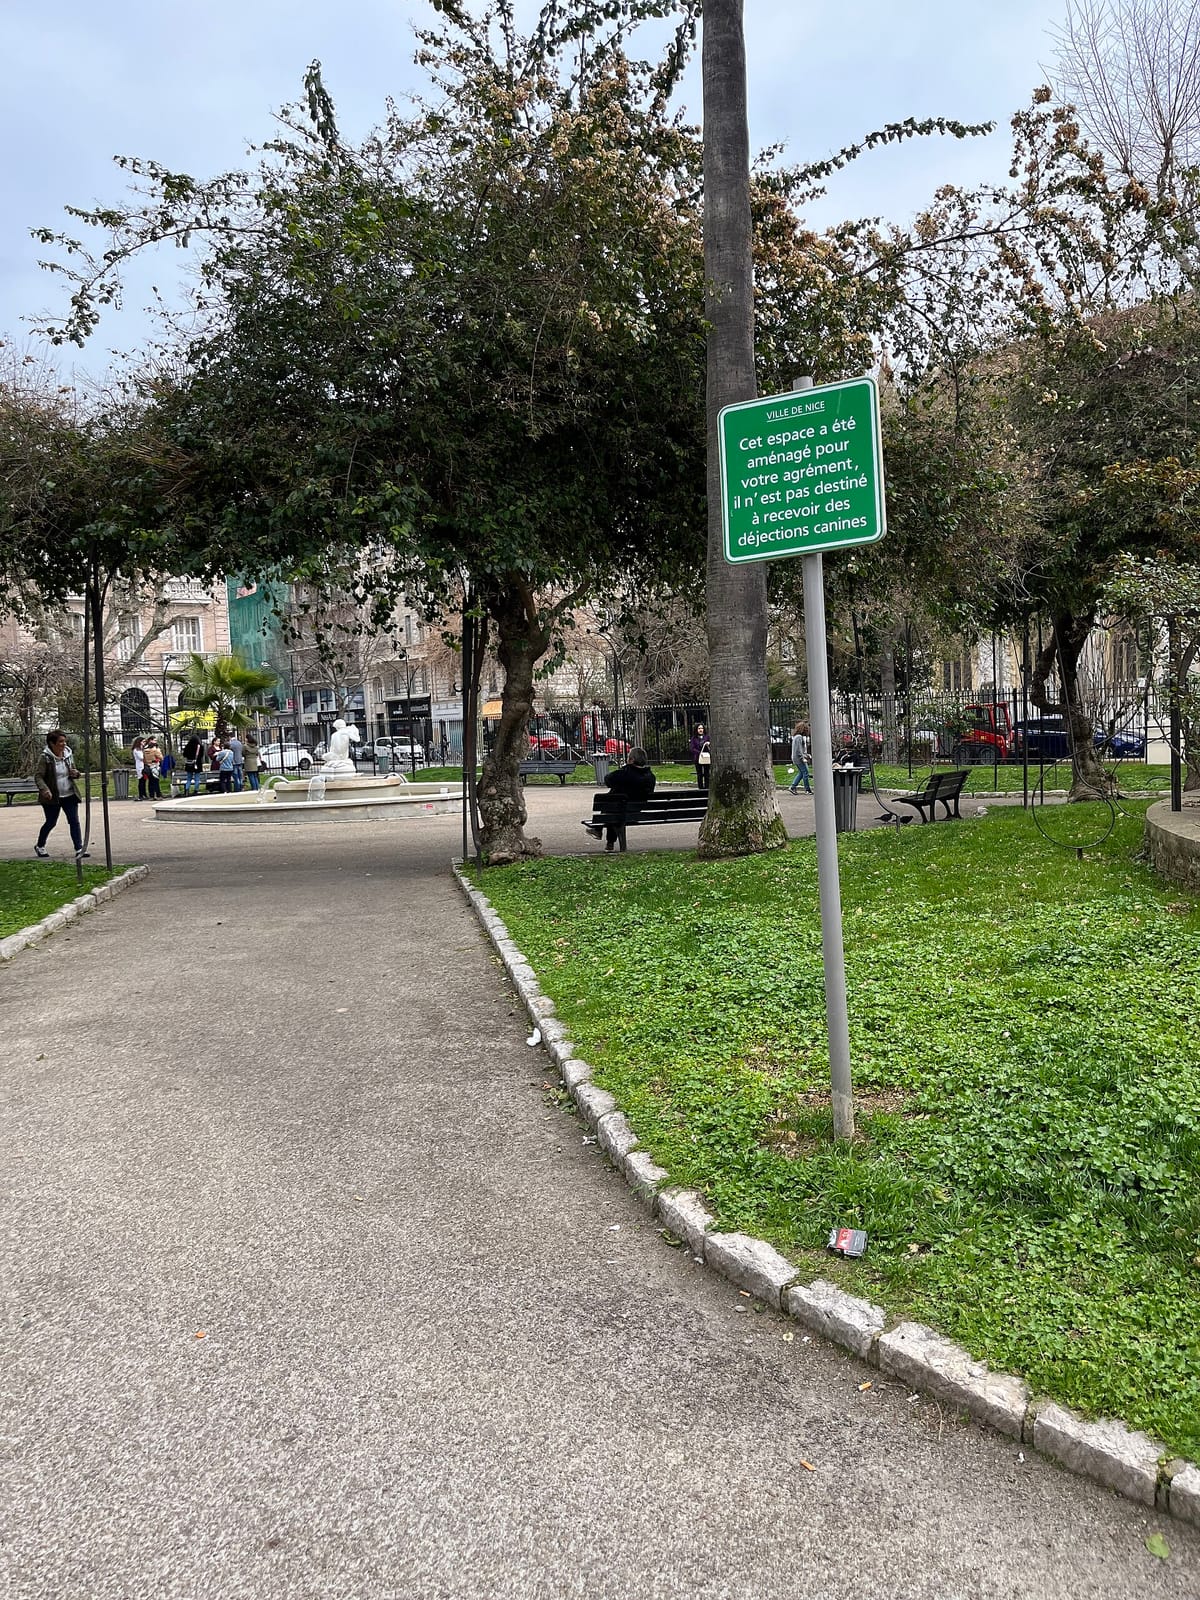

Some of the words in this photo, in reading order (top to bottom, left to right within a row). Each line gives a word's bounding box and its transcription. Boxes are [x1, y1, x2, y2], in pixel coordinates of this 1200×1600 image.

[766, 408, 789, 420] VILLE
[791, 405, 803, 415] DE
[805, 400, 825, 412] NICE
[739, 436, 763, 451] Cet
[767, 427, 815, 446] espace
[819, 425, 827, 435] a
[832, 415, 856, 433] été
[747, 444, 811, 469] aménagé
[815, 440, 850, 459] pour
[741, 473, 778, 488] votre
[783, 458, 859, 483] agrément,
[734, 495, 740, 509] il
[786, 486, 810, 503] pas
[814, 472, 868, 495] destiné
[752, 511, 760, 525] à
[764, 502, 820, 523] recevoir
[825, 498, 850, 512] des
[738, 525, 809, 547] déjections
[813, 516, 867, 534] canines
